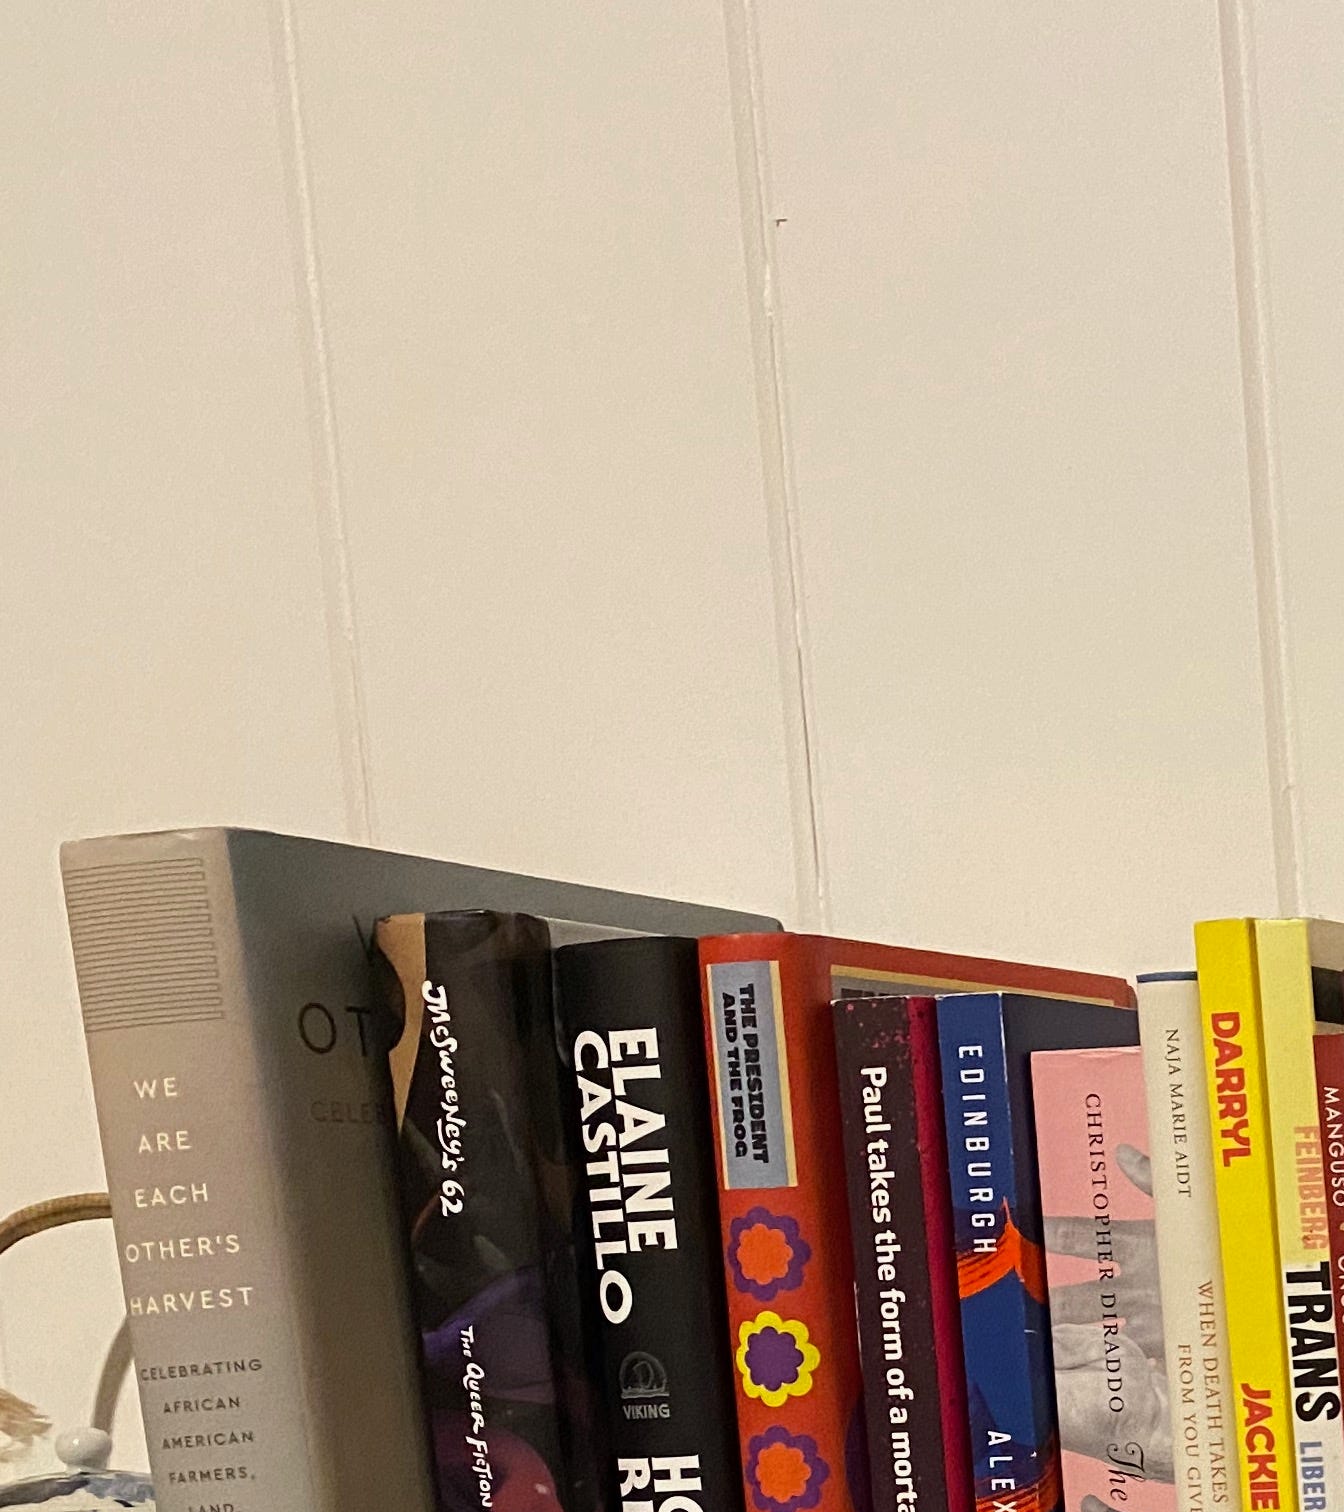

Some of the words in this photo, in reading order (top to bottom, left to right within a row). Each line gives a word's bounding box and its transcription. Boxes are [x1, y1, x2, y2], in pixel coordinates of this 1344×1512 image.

[721, 992, 740, 1053] AND
[739, 983, 756, 1027] THE
[725, 1057, 744, 1095] THE
[1165, 1028, 1183, 1076] NAJA
[134, 1077, 178, 1098] WE
[741, 1030, 770, 1164] PRESIDENT
[861, 1066, 892, 1132] Paul
[729, 1097, 748, 1158] FROG
[1168, 1080, 1187, 1144] MARIE
[138, 1131, 192, 1154] ARE
[608, 1027, 678, 1252] ELAINE
[958, 1045, 998, 1253] EDINBURGH
[134, 1183, 209, 1208] EACH
[573, 1030, 633, 1325] CASTILLO
[865, 1139, 896, 1220] takes
[1174, 1149, 1192, 1198] AIDT
[440, 1180, 465, 1217] 62
[126, 1235, 240, 1264] OTHER'S
[873, 1226, 903, 1281] the
[1085, 1093, 1117, 1283] CHRISTOPHER
[1101, 1293, 1125, 1414] DIRADDO
[1211, 1012, 1254, 1168] DARRYL
[1241, 1383, 1281, 1511] JACKIE
[130, 1287, 254, 1317] HARVEST
[878, 1290, 907, 1361] form
[1286, 1261, 1342, 1423] TRANS
[140, 1356, 263, 1381] CELEBRATING
[884, 1368, 912, 1397] of
[163, 1395, 241, 1414] AFRICAN
[622, 1403, 671, 1420] VIKING
[890, 1406, 908, 1424] a
[161, 1430, 255, 1450] AMERICAN
[168, 1465, 257, 1486] FARMERS,
[1106, 1441, 1146, 1502] The
